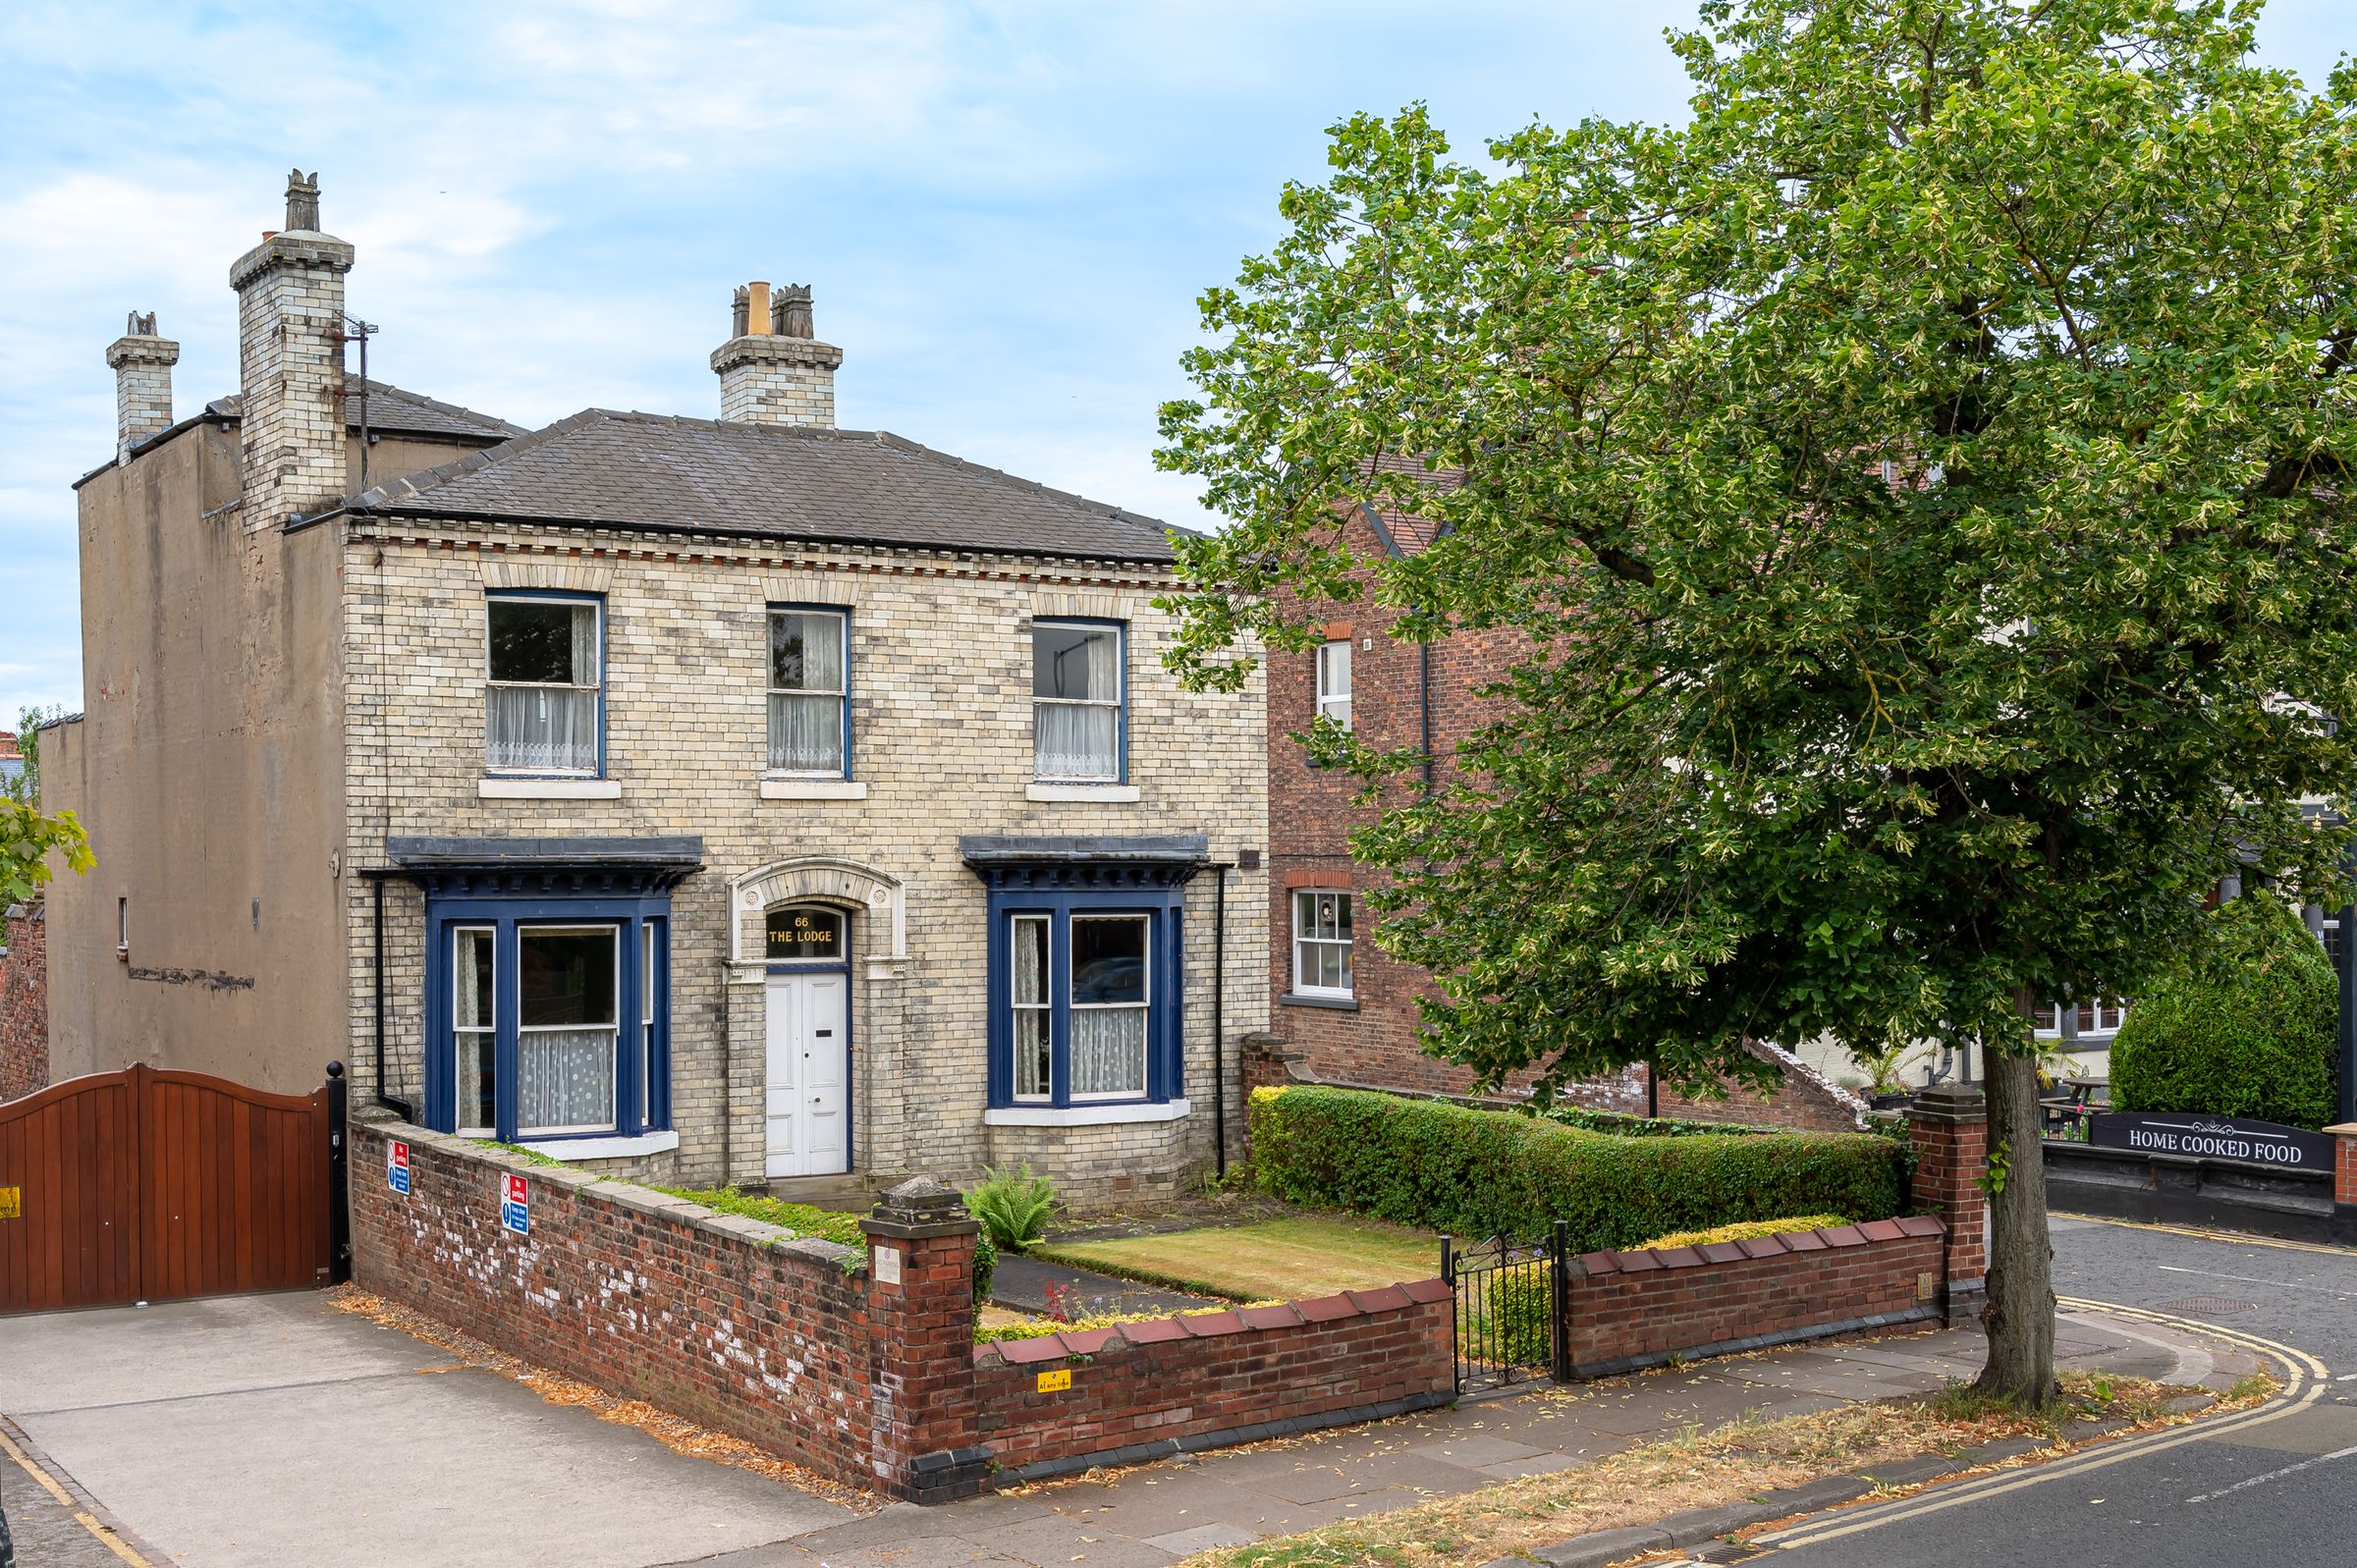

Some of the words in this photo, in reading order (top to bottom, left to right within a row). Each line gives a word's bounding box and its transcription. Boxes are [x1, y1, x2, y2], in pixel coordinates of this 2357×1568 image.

[795, 917, 809, 927] 66
[769, 931, 793, 943] THE
[797, 931, 833, 943] LODGE
[2129, 1129, 2178, 1151] HOME
[2181, 1135, 2250, 1158] COOKED
[2254, 1142, 2303, 1163] FOOD
[515, 1178, 521, 1188] No
[512, 1189, 525, 1202] parking
